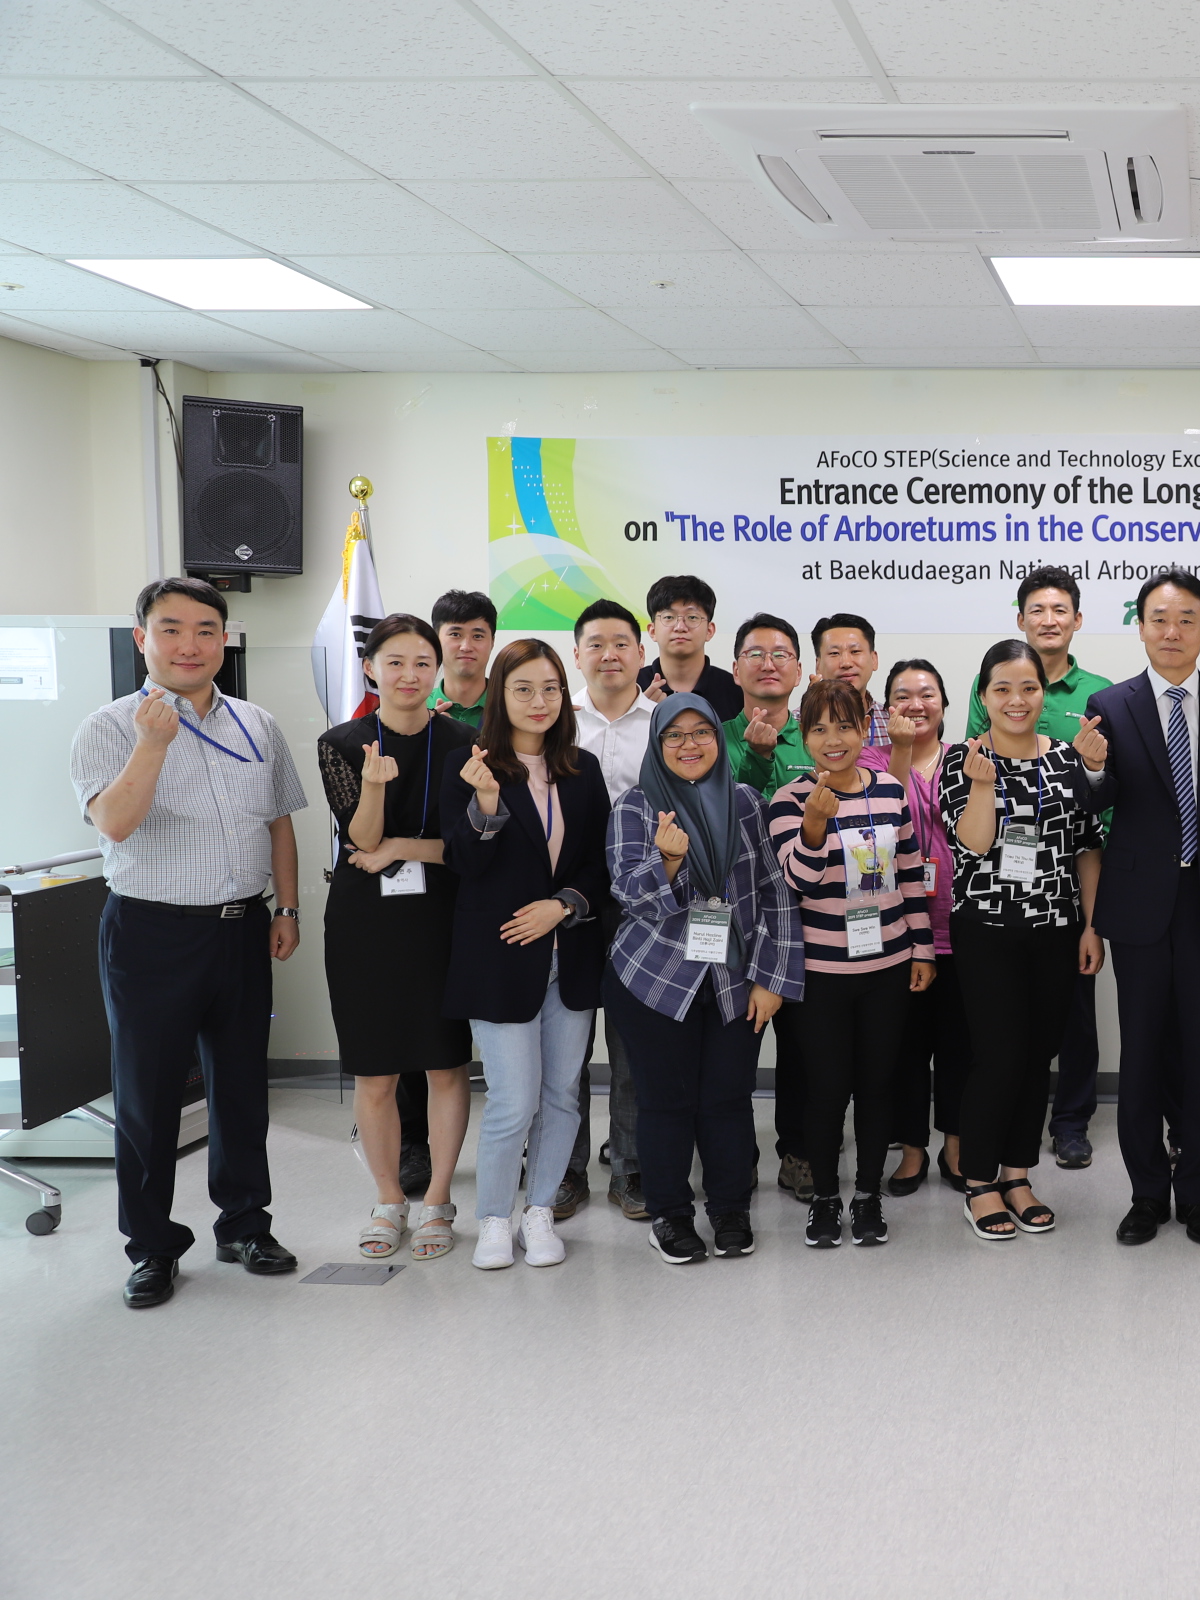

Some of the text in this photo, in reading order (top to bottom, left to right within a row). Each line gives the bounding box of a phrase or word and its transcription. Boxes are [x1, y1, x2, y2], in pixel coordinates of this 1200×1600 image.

[816, 450, 878, 469] AFoCO
[883, 448, 1011, 472] STEP(Science
[1016, 449, 1051, 469] and
[1057, 449, 1166, 473] Technology
[780, 476, 899, 505] Entrance
[906, 476, 1047, 510] Ceremony
[1053, 476, 1083, 504] of
[1087, 476, 1133, 505] the
[624, 520, 658, 542] on
[664, 512, 725, 542] "The
[733, 514, 792, 542] Role
[800, 514, 830, 542] of
[833, 515, 997, 542] Arboretums
[1005, 513, 1029, 542] in
[1037, 514, 1083, 542] the
[802, 561, 823, 580] at
[830, 559, 991, 585] Baekdudaegan
